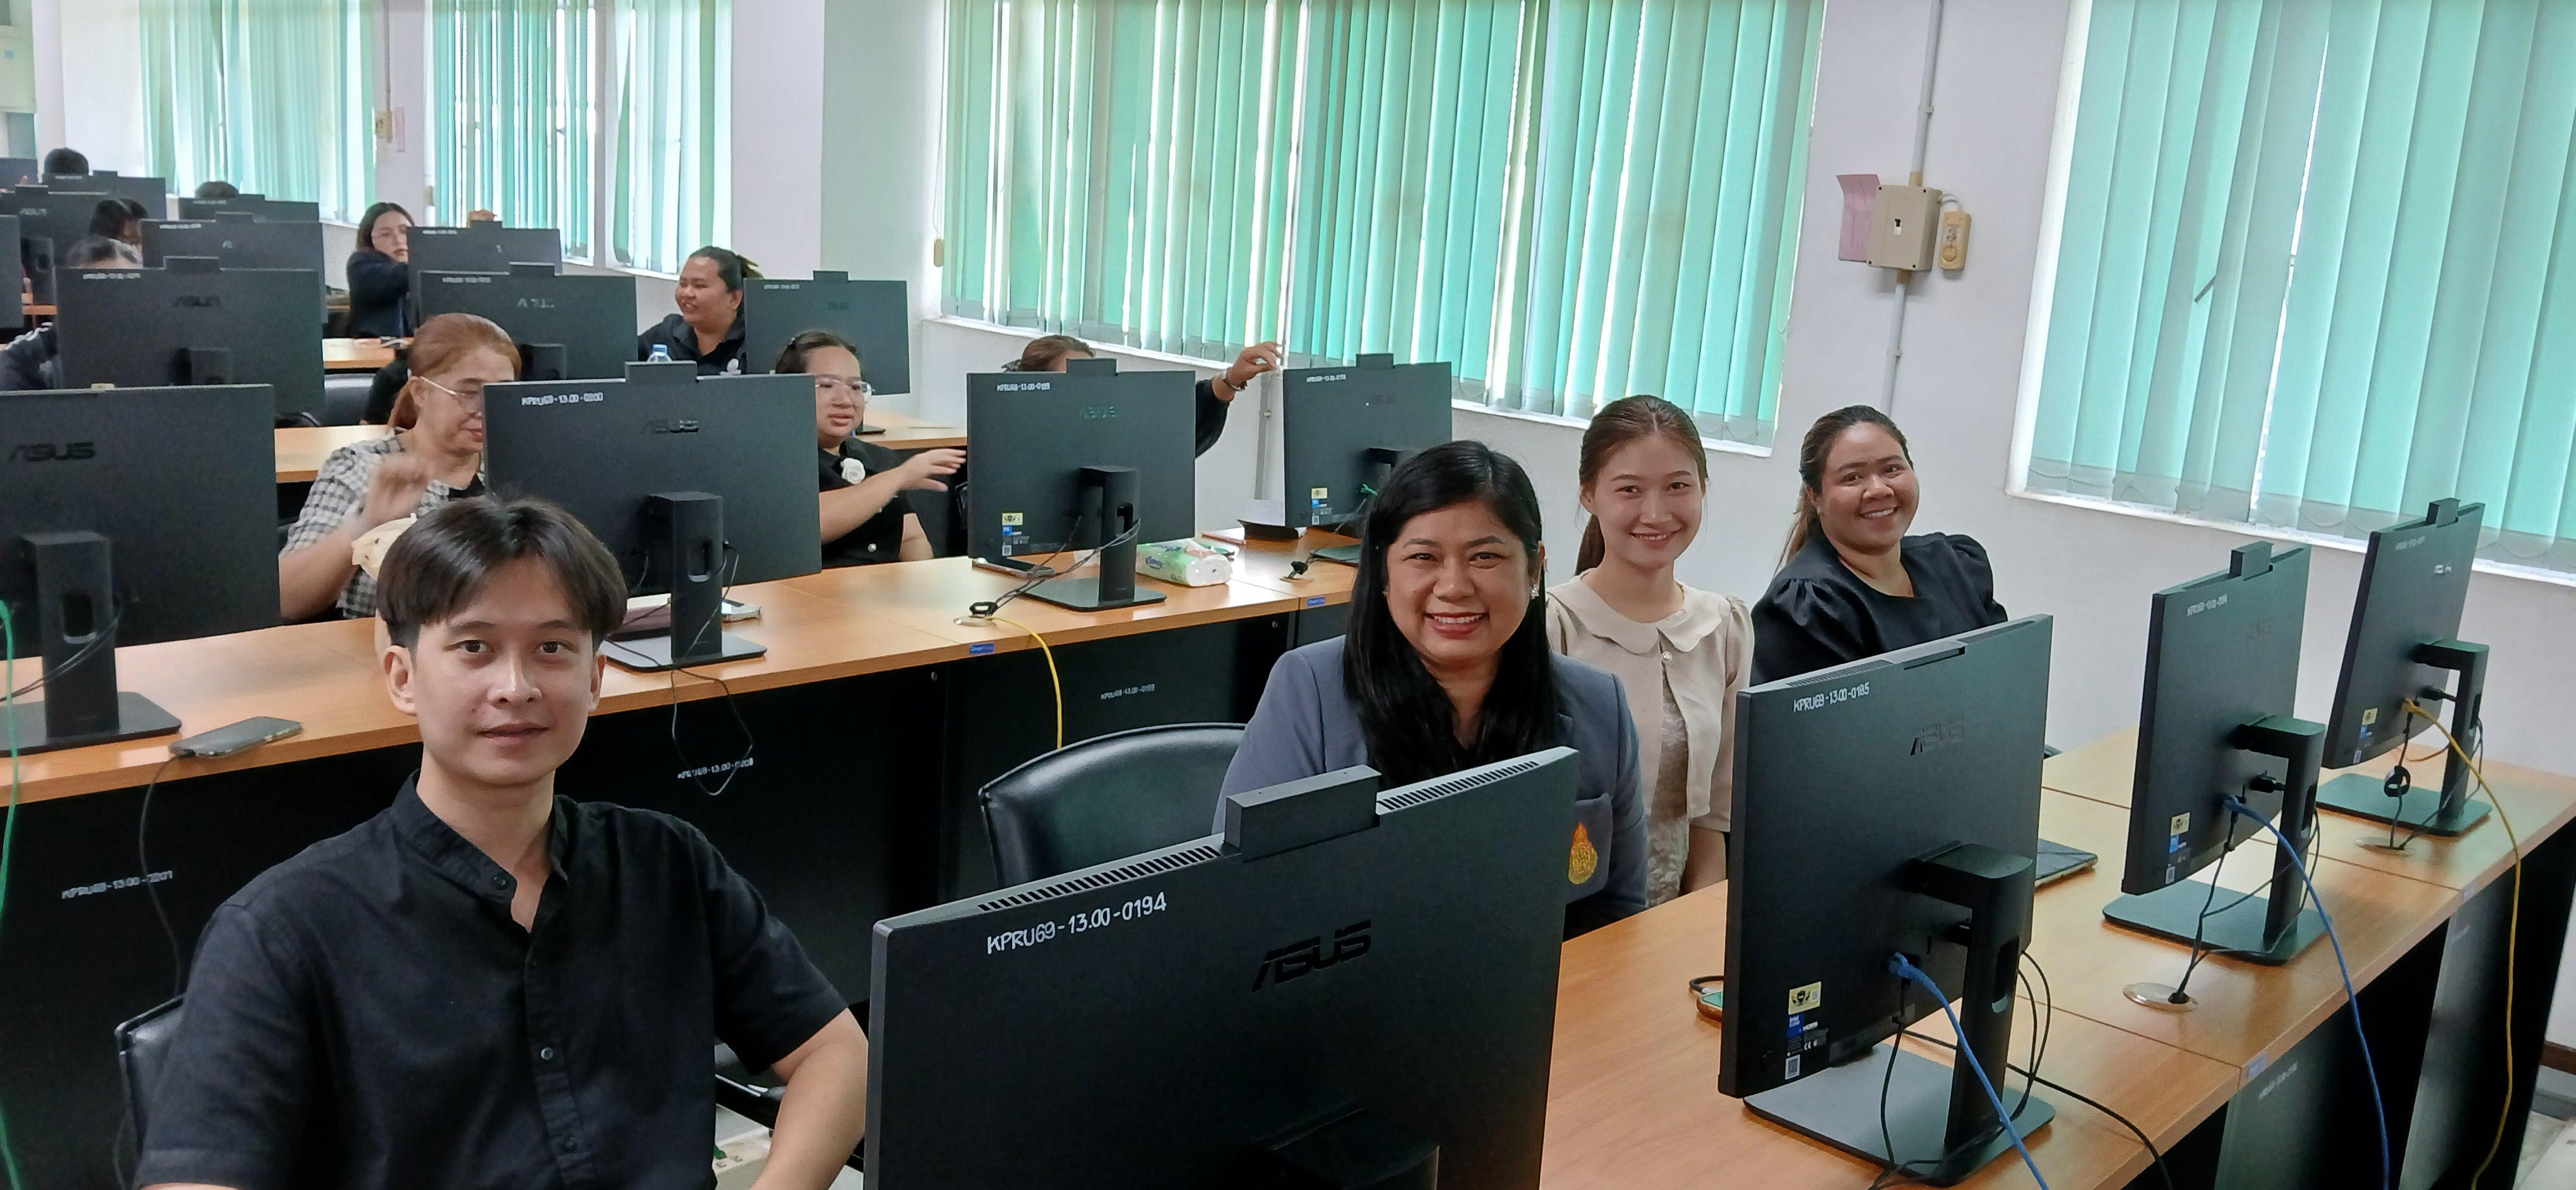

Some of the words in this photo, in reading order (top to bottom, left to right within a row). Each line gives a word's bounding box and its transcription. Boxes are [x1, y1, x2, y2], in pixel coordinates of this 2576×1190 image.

[9, 442, 95, 463] ASUS
[1793, 682, 1869, 712] KPRU69-13.00-0185
[986, 891, 1167, 955] KPRU69-13.00-0194
[1251, 920, 1372, 992] ASUS
